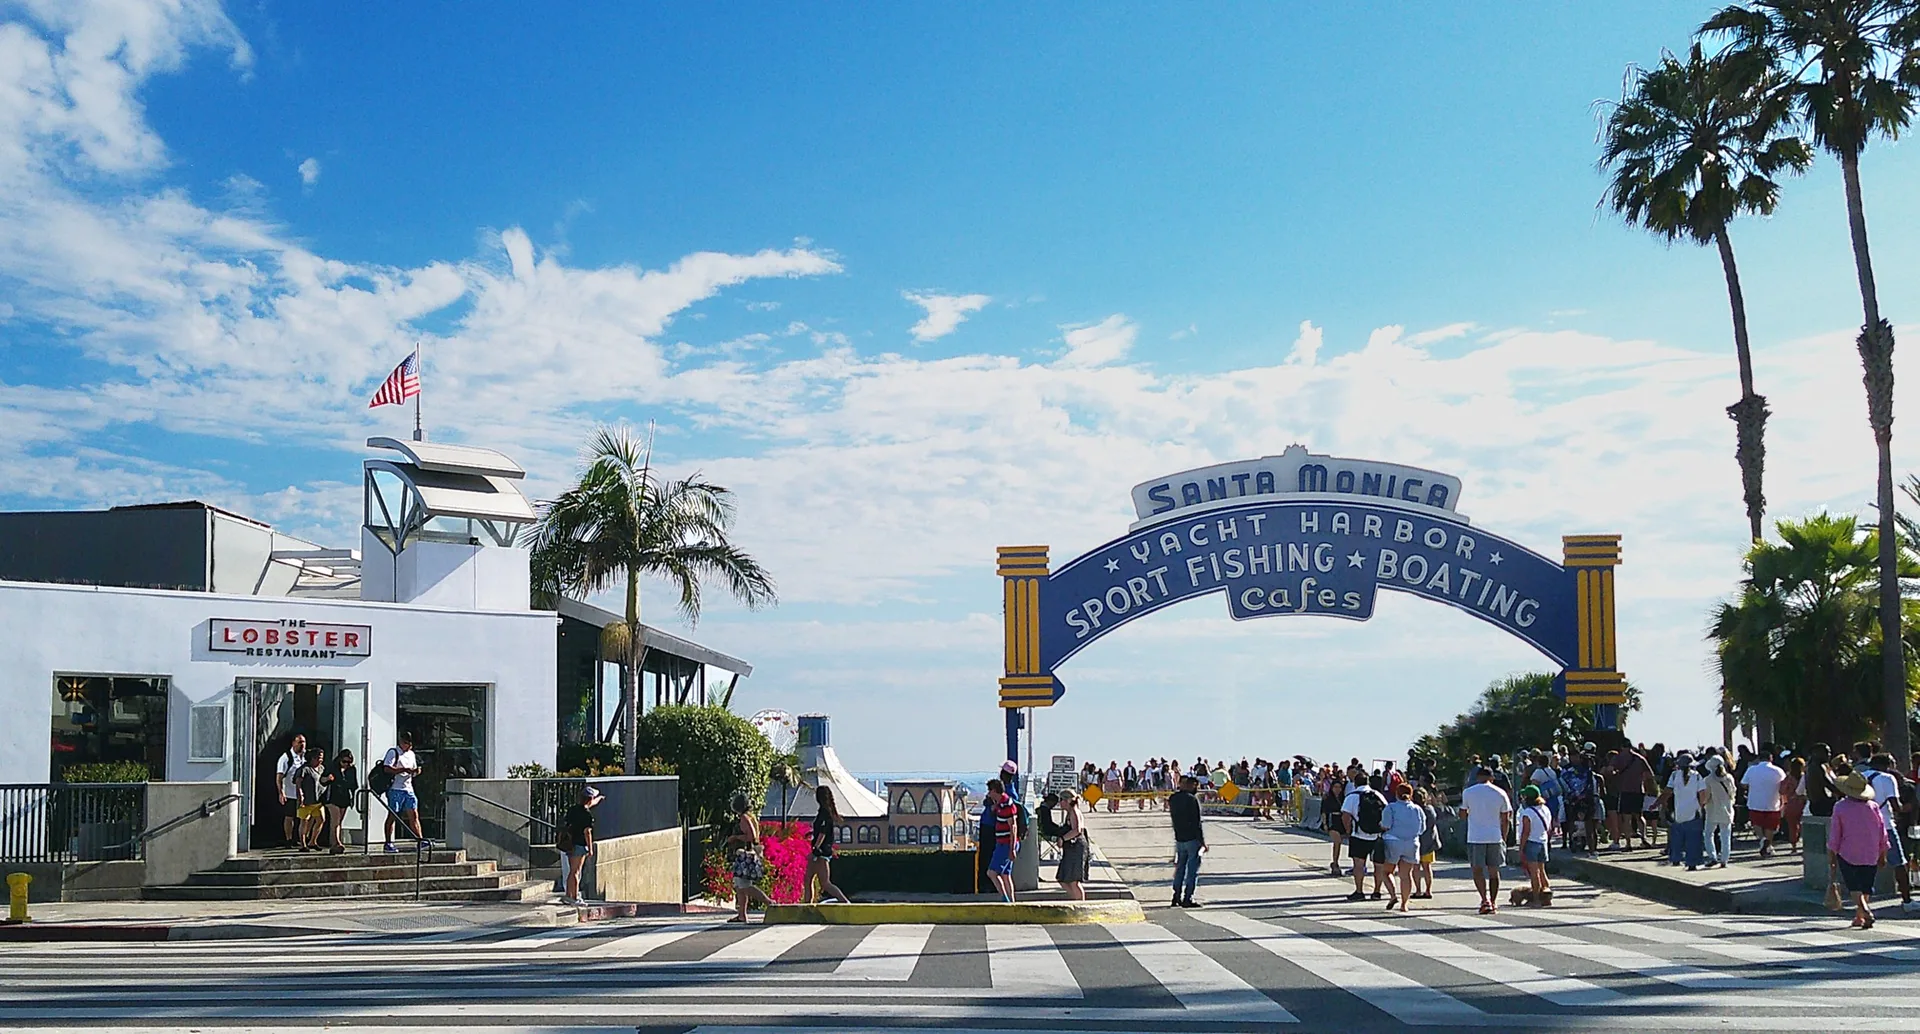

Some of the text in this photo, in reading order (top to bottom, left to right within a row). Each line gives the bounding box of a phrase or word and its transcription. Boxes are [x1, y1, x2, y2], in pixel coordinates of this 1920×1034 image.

[1148, 464, 1449, 515] SANTA MONICA
[1130, 511, 1476, 564] YACHT HARBOR
[1065, 543, 1540, 639] SPORT FISHING BOATING
[224, 628, 359, 648] LOBSTER
[279, 619, 306, 628] THE
[246, 647, 337, 659] RESTAURANT
